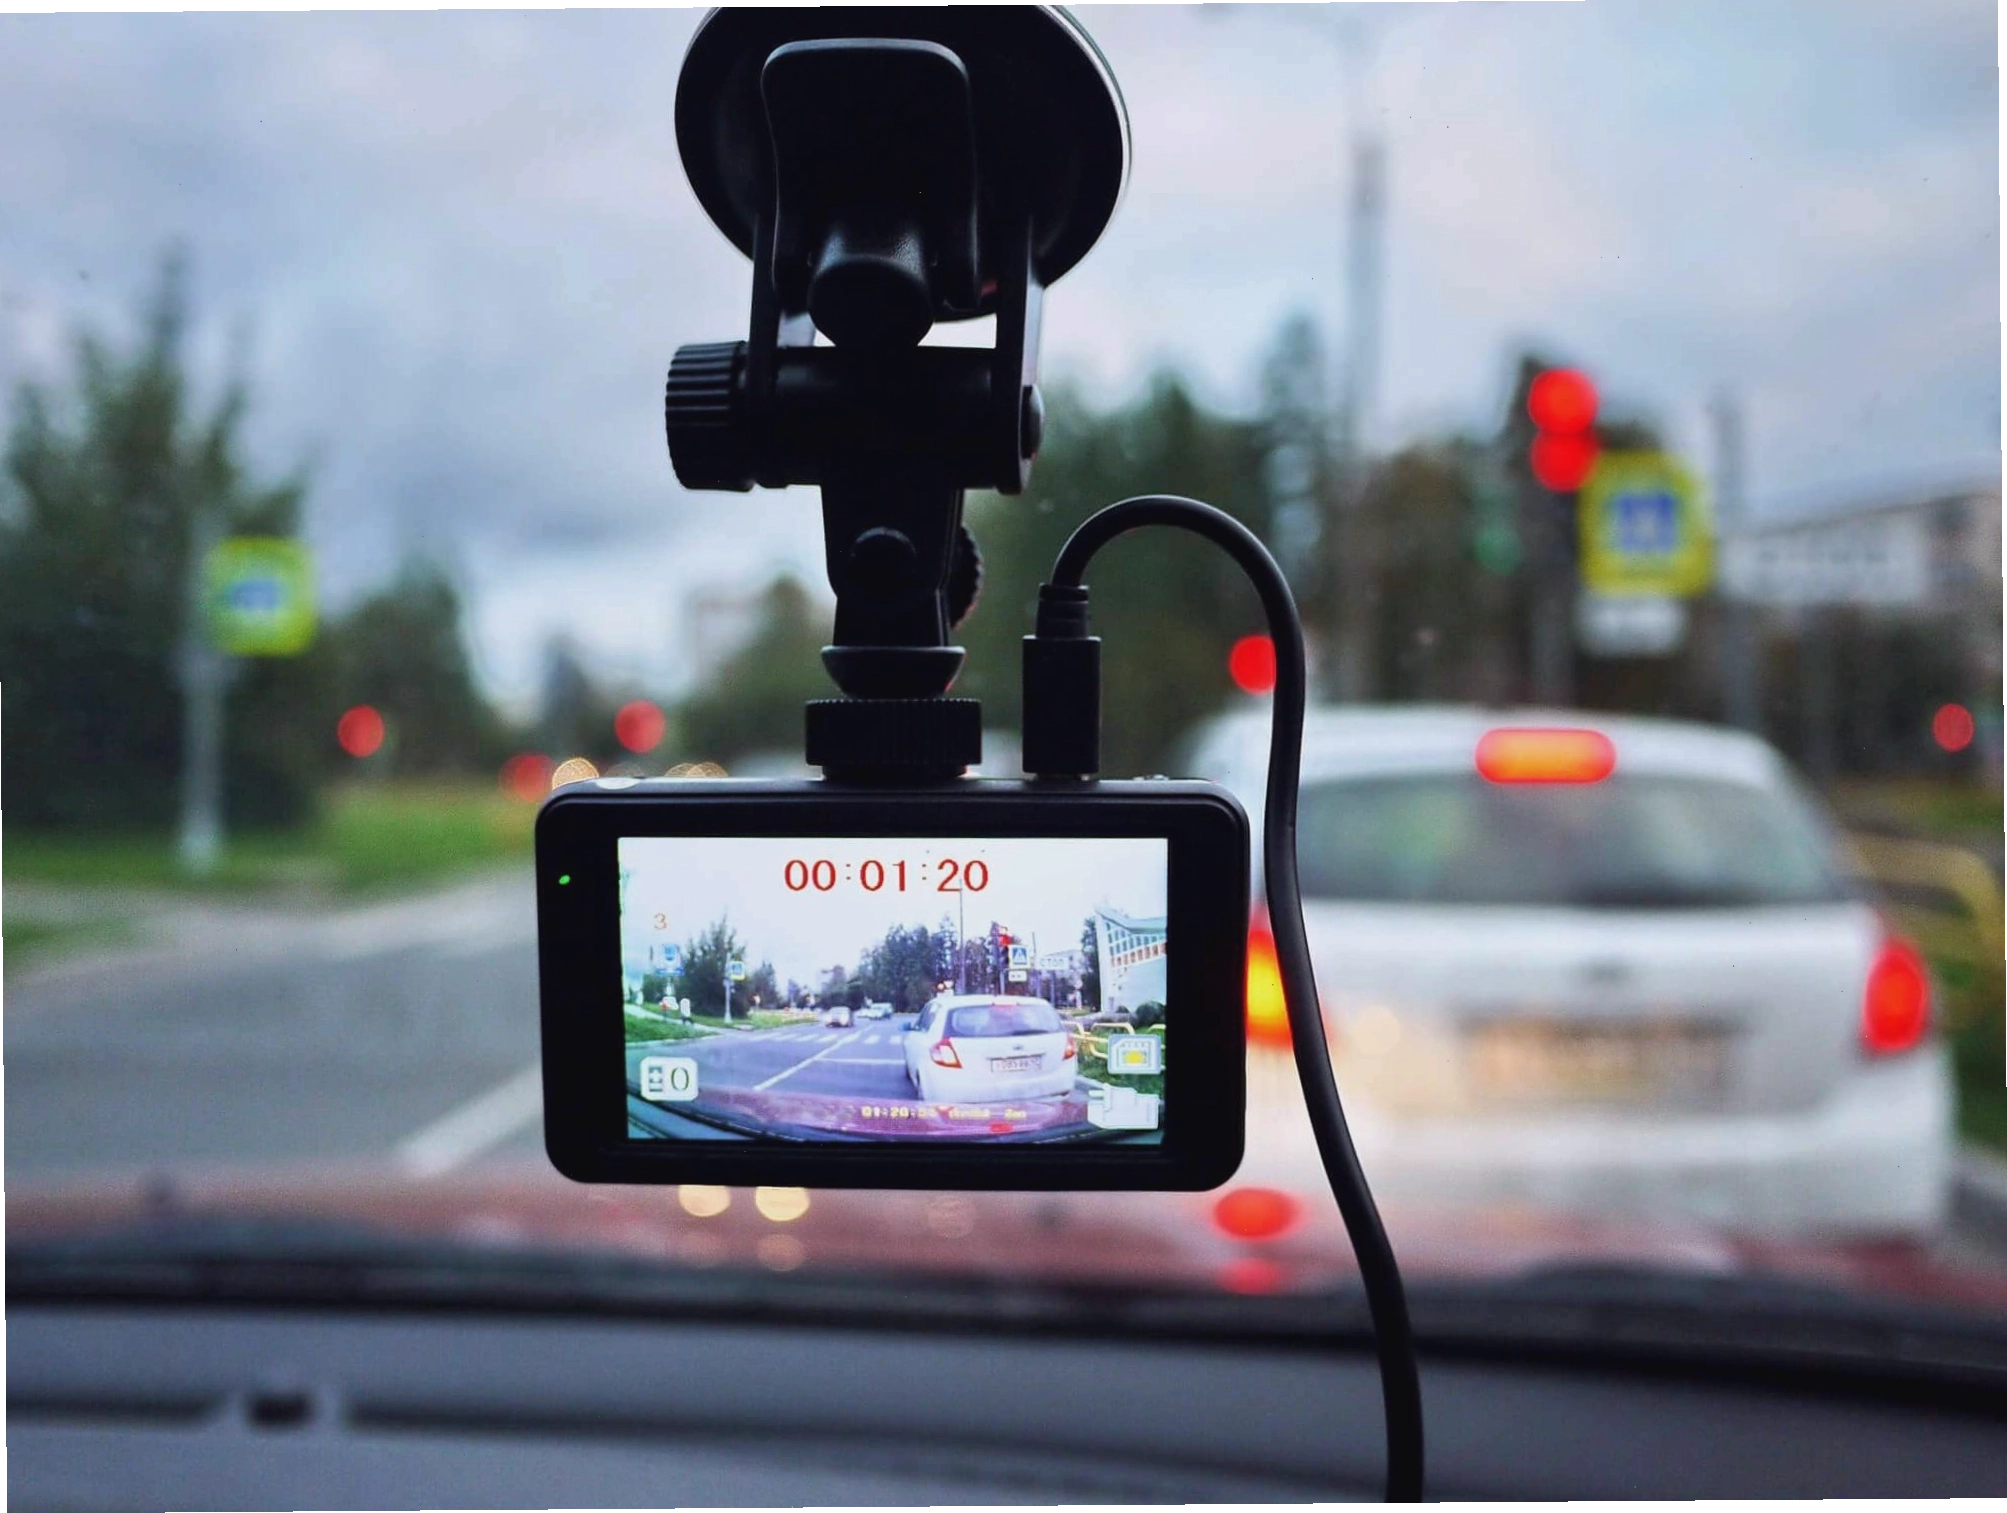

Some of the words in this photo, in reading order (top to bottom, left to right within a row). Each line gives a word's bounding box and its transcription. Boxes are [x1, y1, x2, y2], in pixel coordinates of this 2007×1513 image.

[784, 858, 989, 892] 00:01:20
[654, 912, 668, 930] 3
[670, 1067, 690, 1091] 0
